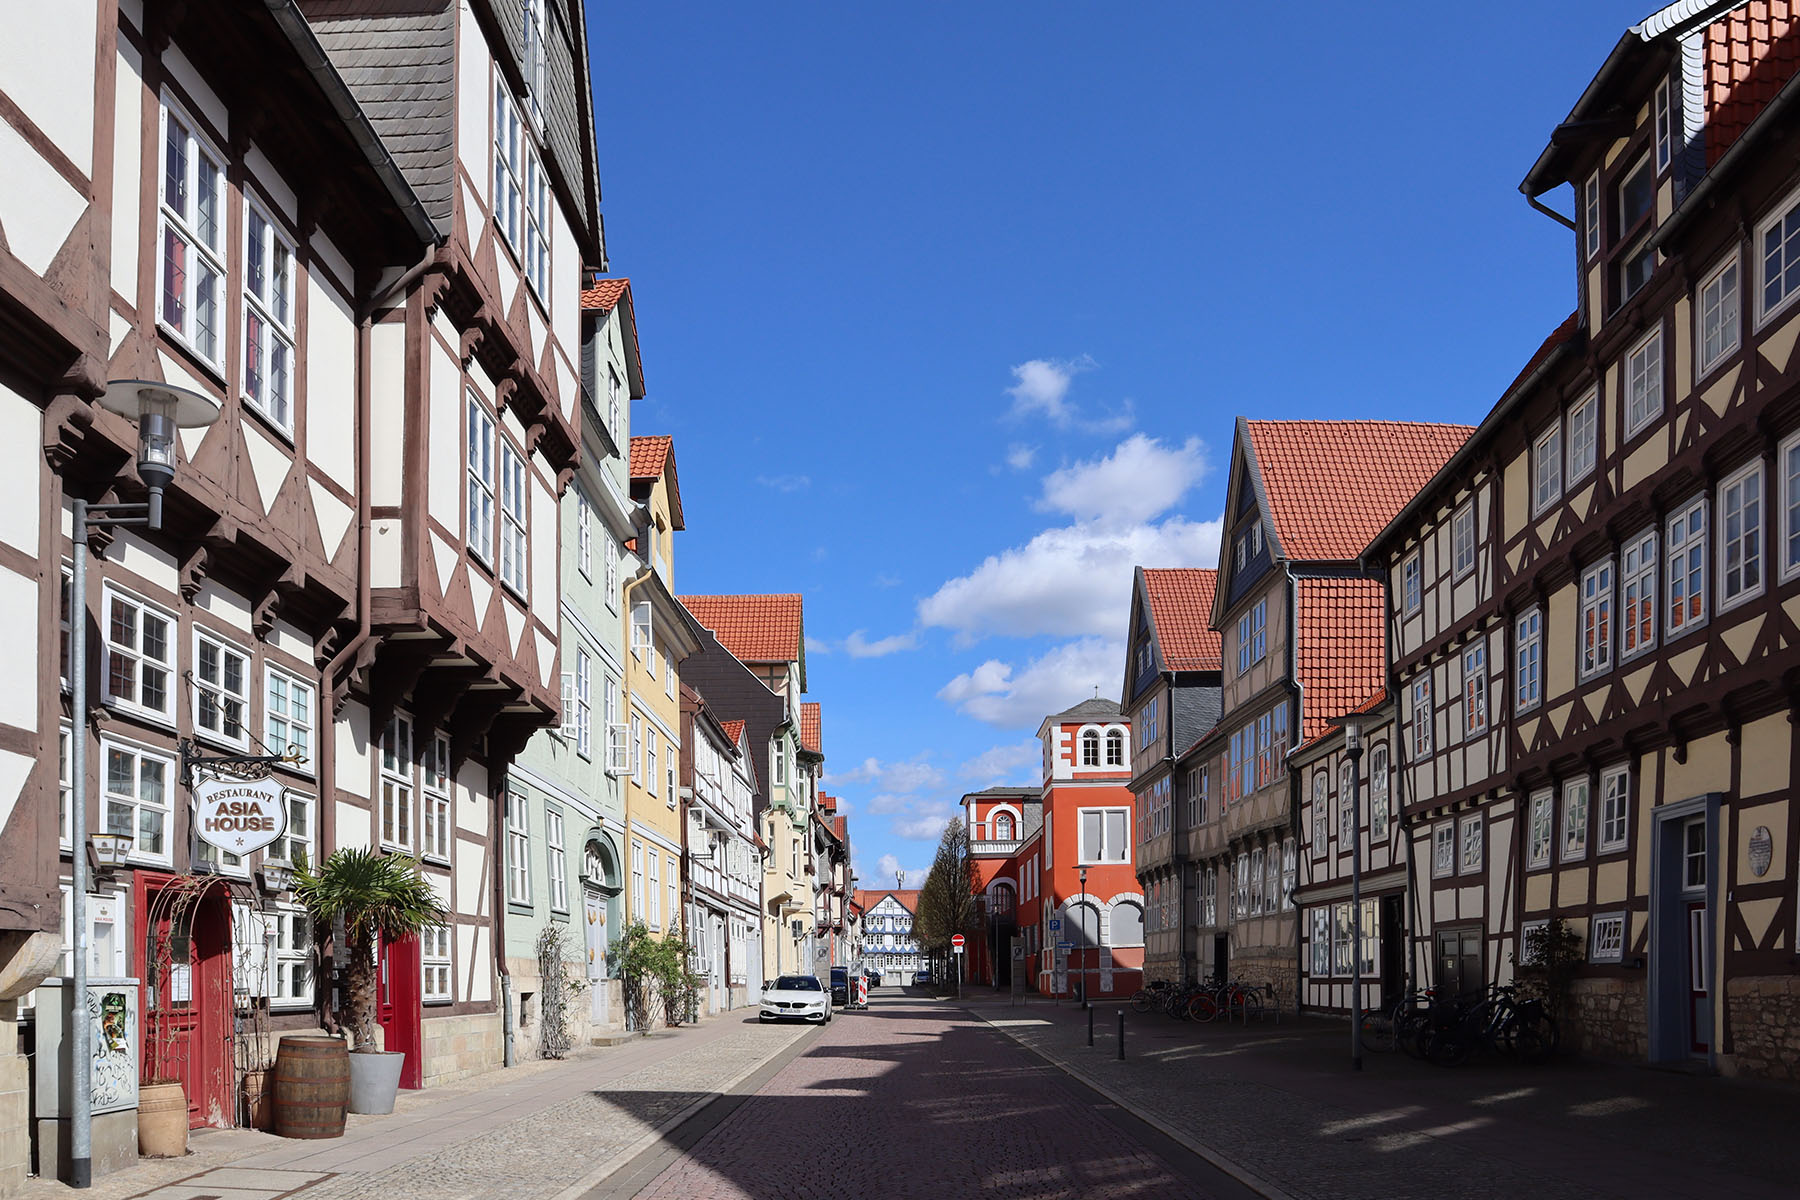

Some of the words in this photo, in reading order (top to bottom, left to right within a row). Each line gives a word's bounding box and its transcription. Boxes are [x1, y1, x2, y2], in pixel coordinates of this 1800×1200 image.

[206, 788, 274, 804] RESTAURANT
[215, 801, 264, 816] ASIA
[204, 816, 275, 832] HOUSE
